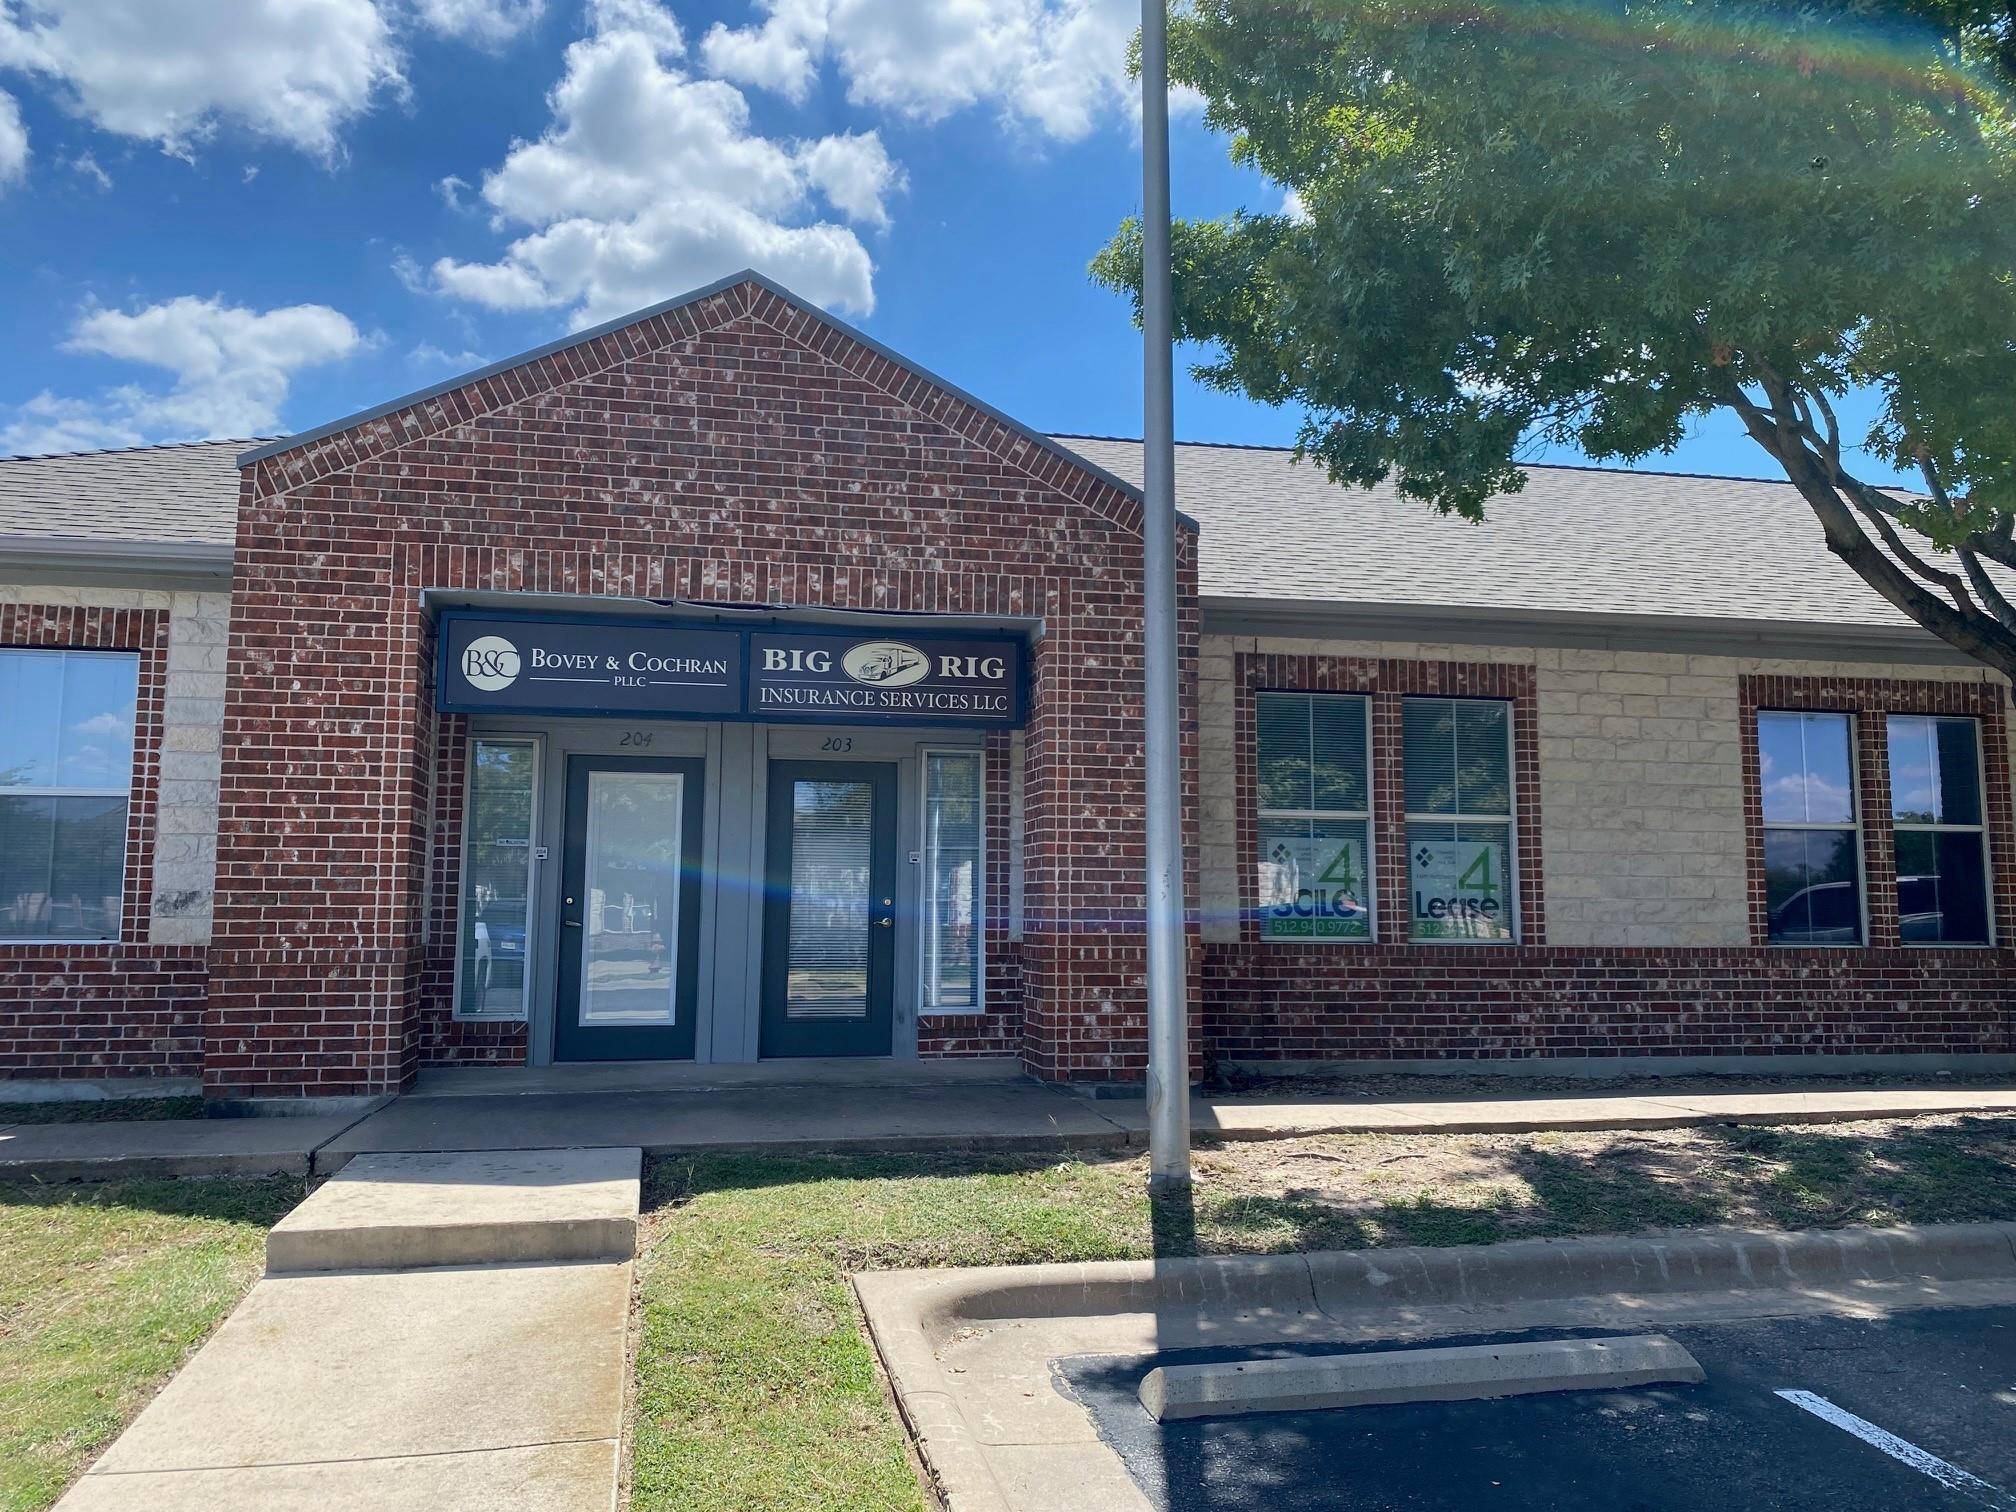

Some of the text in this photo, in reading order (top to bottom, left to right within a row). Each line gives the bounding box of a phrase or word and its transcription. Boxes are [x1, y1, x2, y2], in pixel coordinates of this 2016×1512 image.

[465, 649, 519, 678] B&C
[531, 648, 728, 674] BOVEY & COCHRAN
[761, 648, 1006, 679] BIG RIG
[614, 675, 646, 688] PLLC
[760, 687, 1008, 711] INSURANCE SERVICES LLC
[619, 732, 653, 747] 204
[822, 736, 852, 752] 203
[1317, 841, 1358, 892] 4
[1459, 846, 1498, 898] 4
[1415, 890, 1500, 919] Lease
